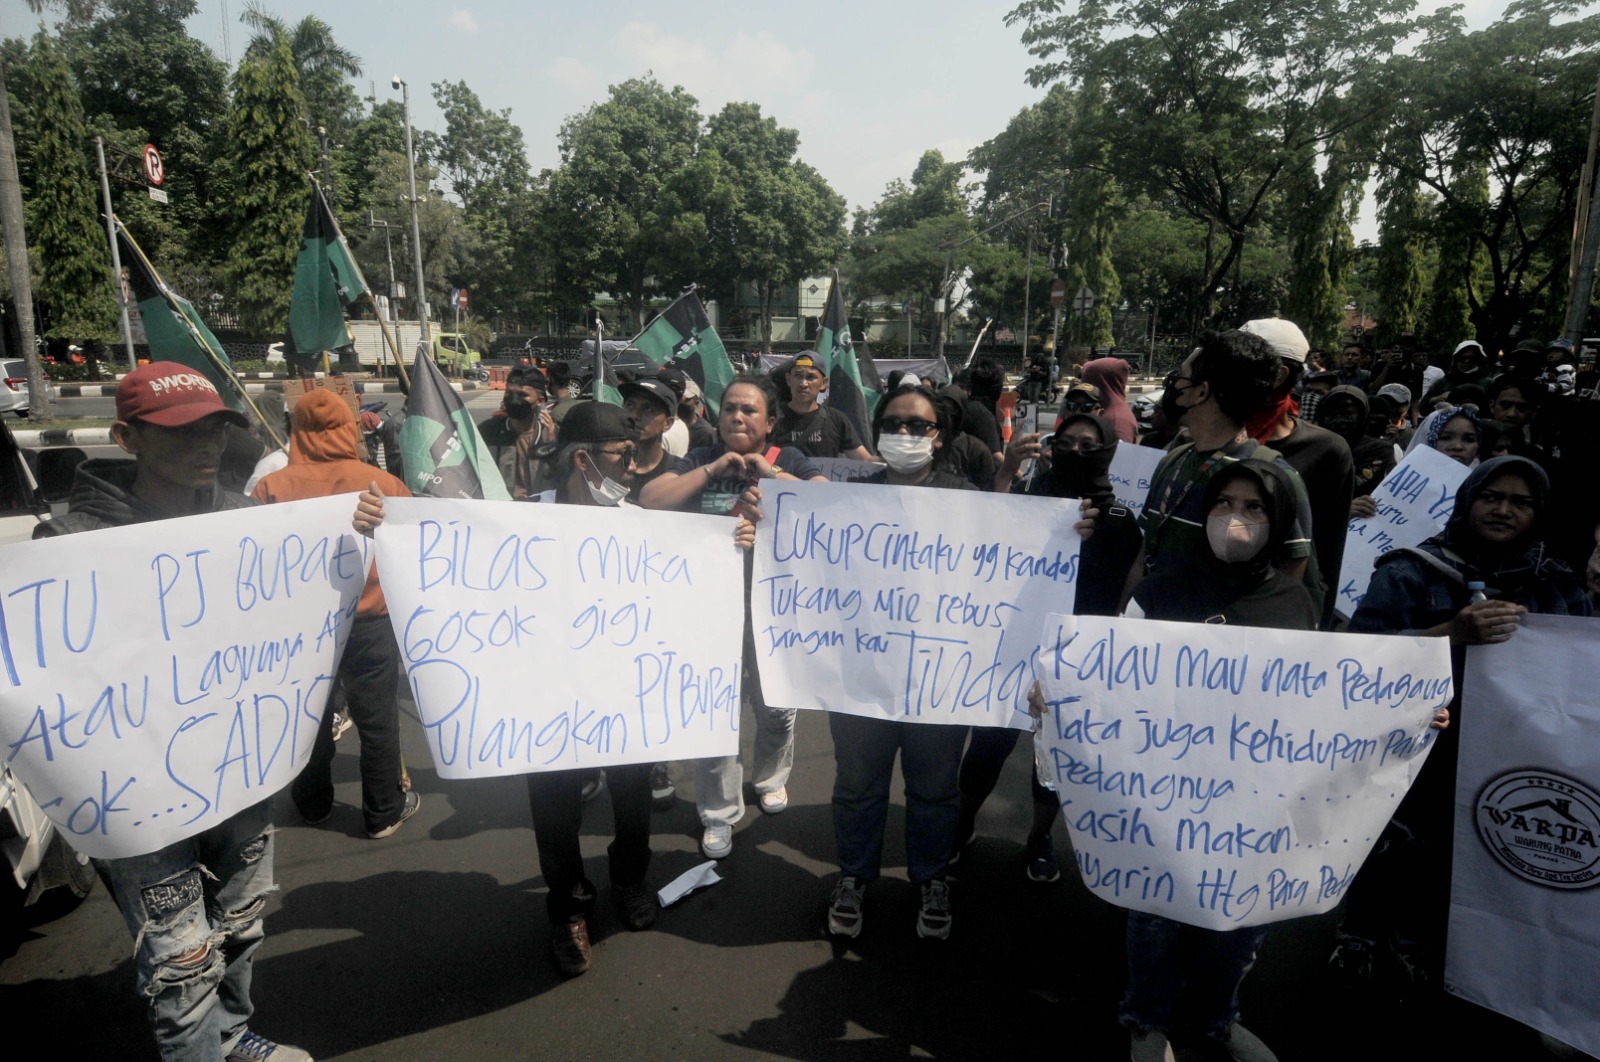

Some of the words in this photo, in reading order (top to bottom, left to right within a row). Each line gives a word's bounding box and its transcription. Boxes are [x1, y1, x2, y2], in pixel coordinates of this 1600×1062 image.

[417, 471, 443, 485] MPO
[1382, 464, 1430, 505] APA
[151, 549, 211, 642] PJ
[1481, 805, 1600, 848] WARPA
[1553, 844, 1582, 860] PATRA
